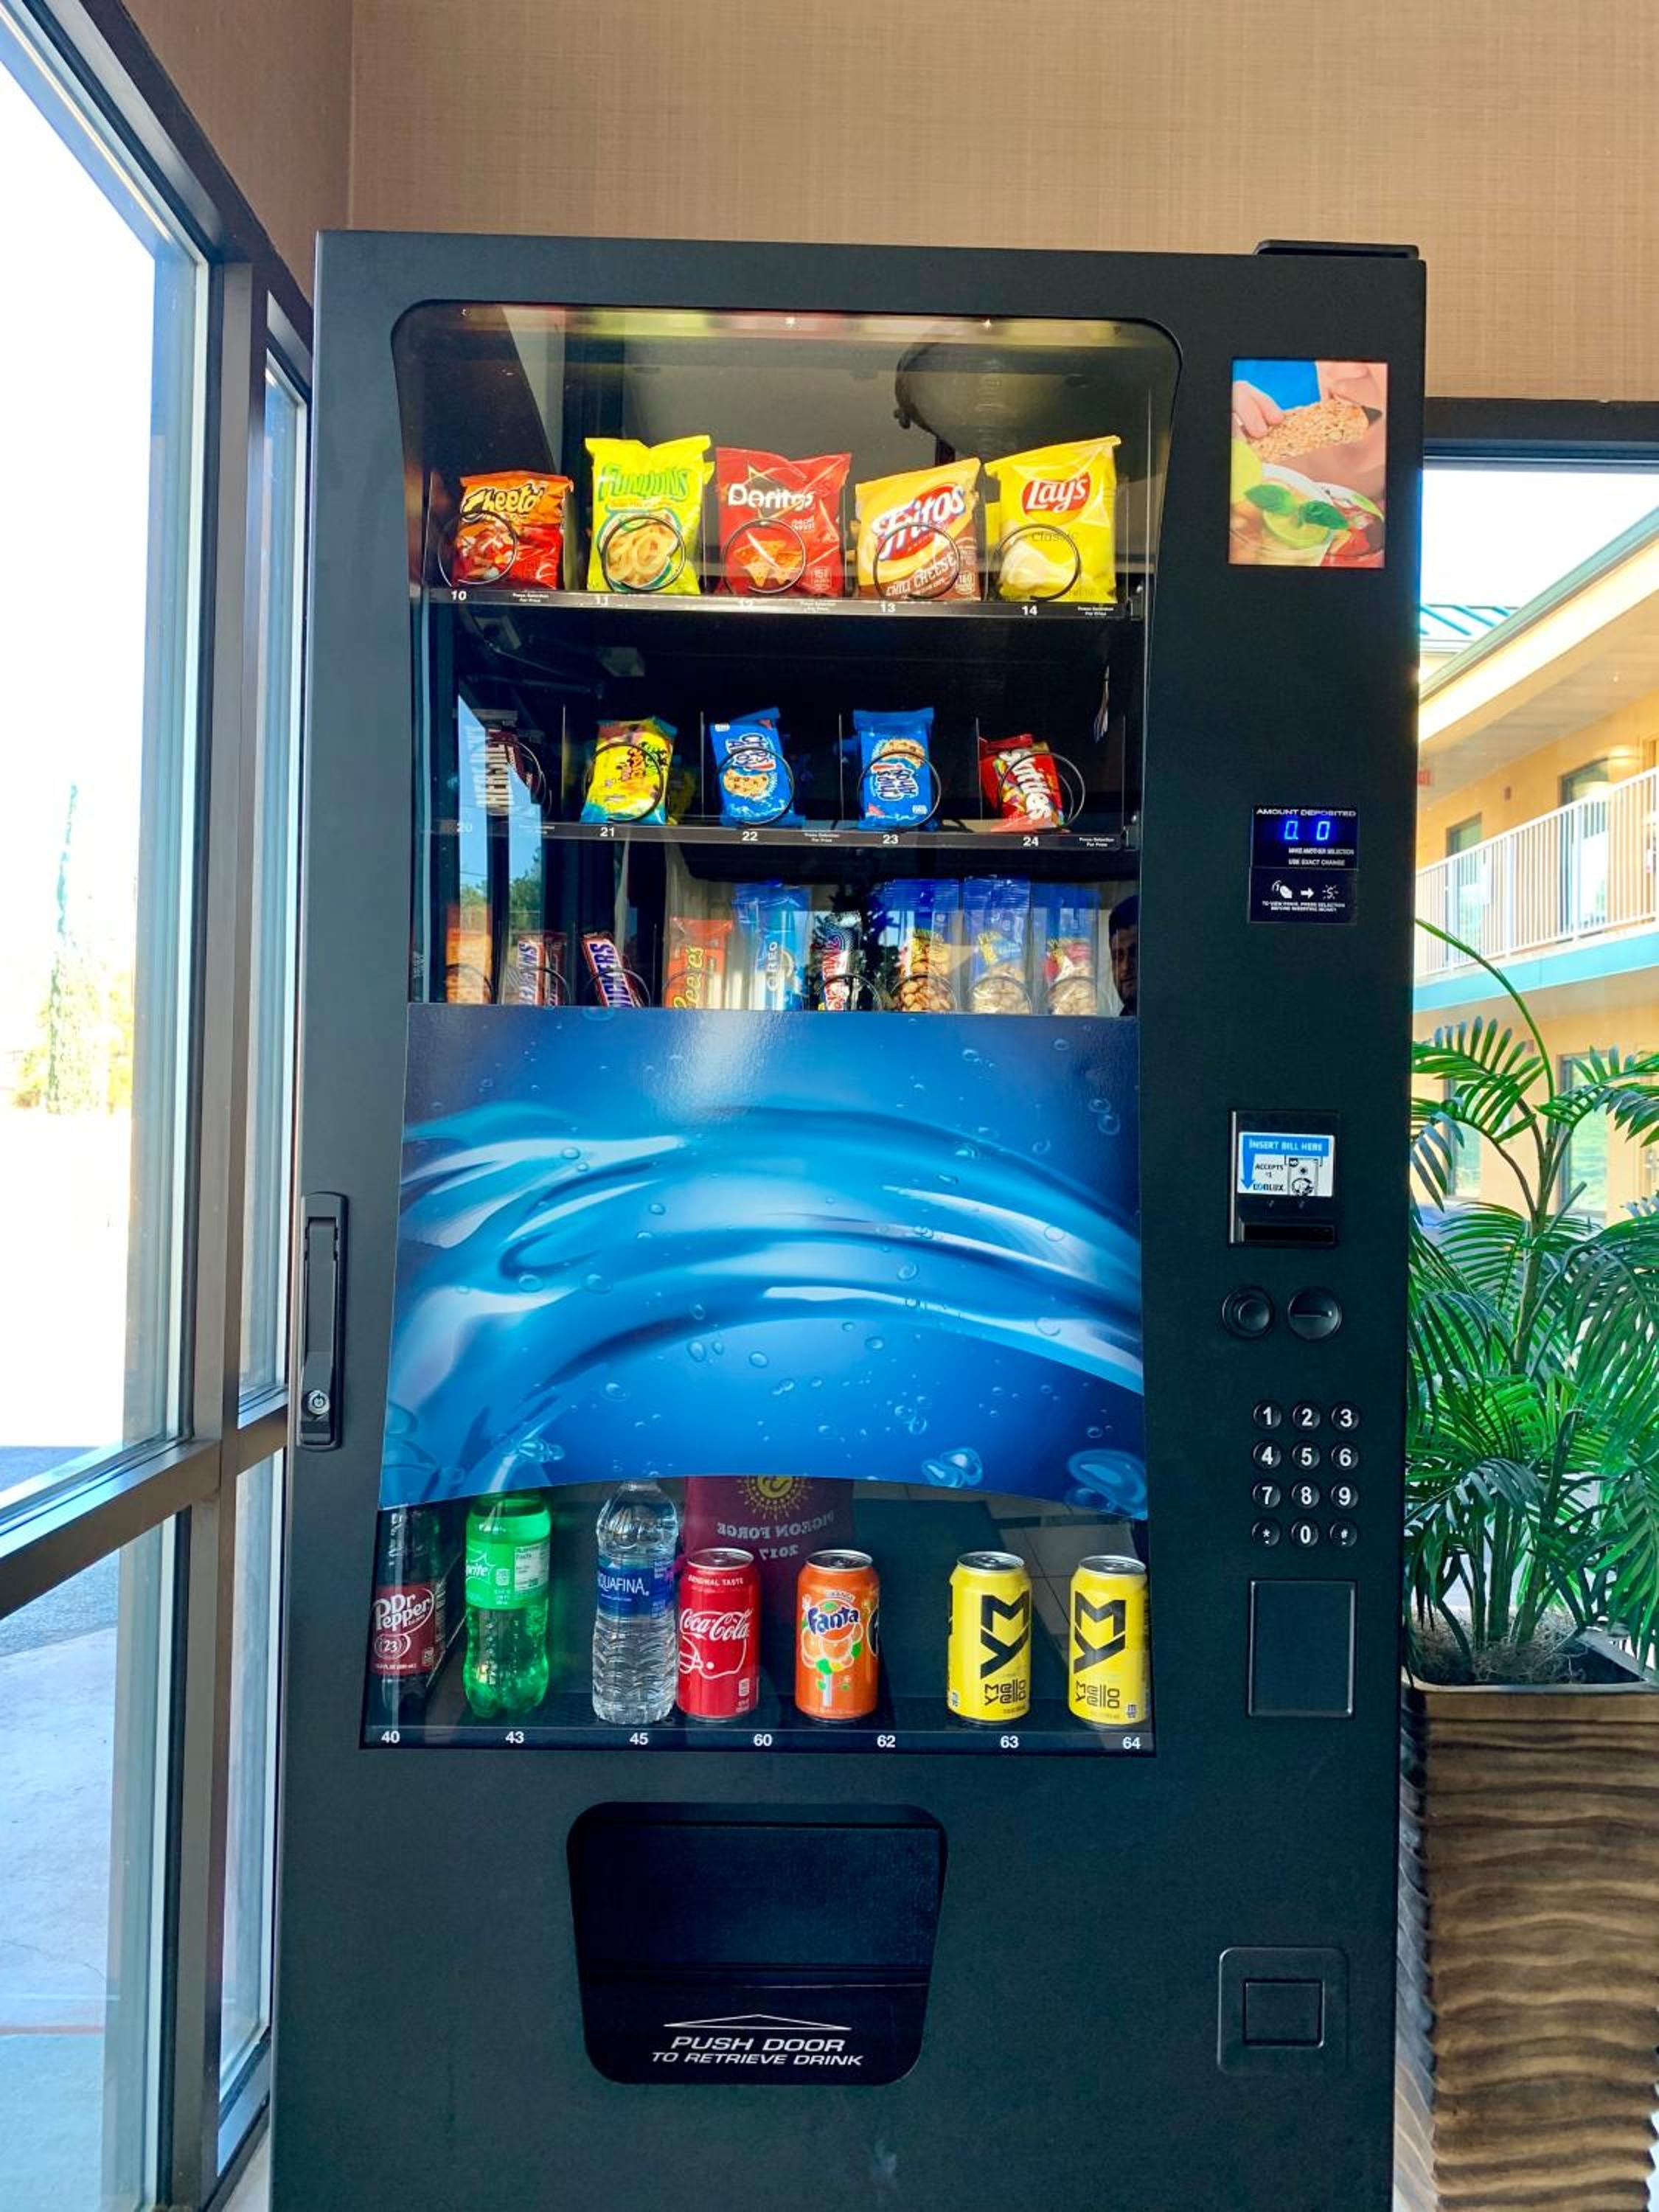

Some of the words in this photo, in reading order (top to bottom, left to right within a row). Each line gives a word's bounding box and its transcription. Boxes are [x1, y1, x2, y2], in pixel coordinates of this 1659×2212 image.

[461, 484, 543, 517] Cheeto
[728, 484, 815, 511] Doritos
[872, 484, 965, 561] Fritos
[451, 591, 467, 600] 10
[880, 603, 896, 613] 13
[1022, 605, 1037, 616] 14
[1300, 809, 1357, 817] DEPOSITED
[600, 827, 615, 836] 21
[742, 832, 758, 841] 22
[883, 835, 899, 844] 23
[1023, 837, 1039, 846] 24
[1248, 1139, 1280, 1150] INSERT
[1263, 1407, 1272, 1425] 1
[1301, 1409, 1313, 1426] 2
[1340, 1410, 1352, 1427] 3
[1261, 1447, 1273, 1465] 4
[1301, 1448, 1312, 1466] 5
[1340, 1449, 1351, 1467] 6
[1262, 1486, 1273, 1505] 7
[1301, 1486, 1312, 1505] 8
[1338, 1487, 1350, 1505] 9
[1300, 1526, 1311, 1544] 0
[722, 1578, 744, 1586] TASTE
[390, 1593, 416, 1614] Dr
[372, 1598, 430, 1632] Pepper
[808, 1607, 859, 1635] Fanta
[384, 1639, 397, 1652] 23
[381, 1731, 400, 1743] 40
[505, 1731, 524, 1744] 43
[630, 1733, 649, 1745] 45
[754, 1733, 773, 1746] 60
[877, 1735, 896, 1747] 62
[1000, 1736, 1019, 1748] 63
[1122, 1737, 1141, 1749] 64
[671, 2037, 752, 2051] PUSH
[762, 2038, 846, 2052] DOOR
[653, 2052, 678, 2063] TO
[685, 2053, 787, 2065] RETRIEVE
[793, 2054, 864, 2066] DRINK
